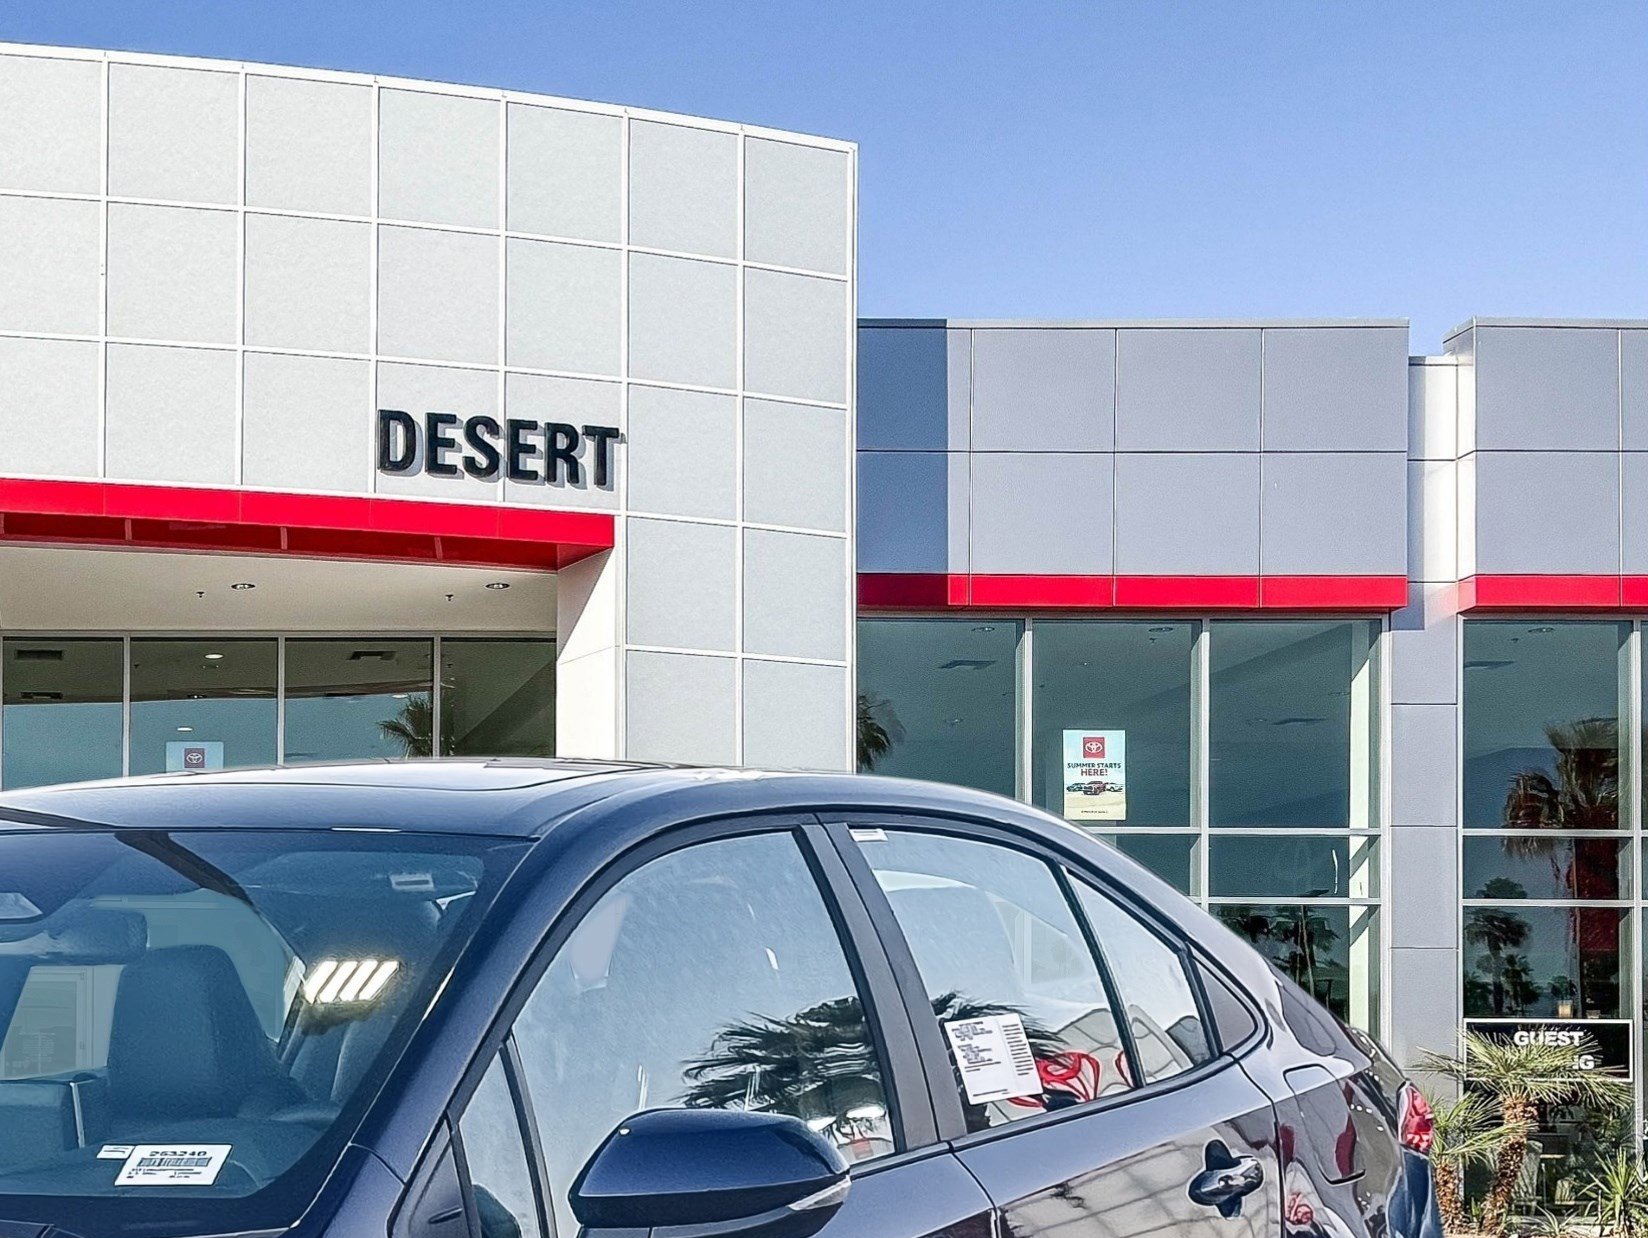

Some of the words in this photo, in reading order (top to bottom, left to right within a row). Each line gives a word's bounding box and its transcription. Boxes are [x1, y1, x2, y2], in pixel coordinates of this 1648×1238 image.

[377, 409, 621, 488] DESERT
[1081, 768, 1108, 776] HERE!
[1513, 1030, 1584, 1047] GUEST
